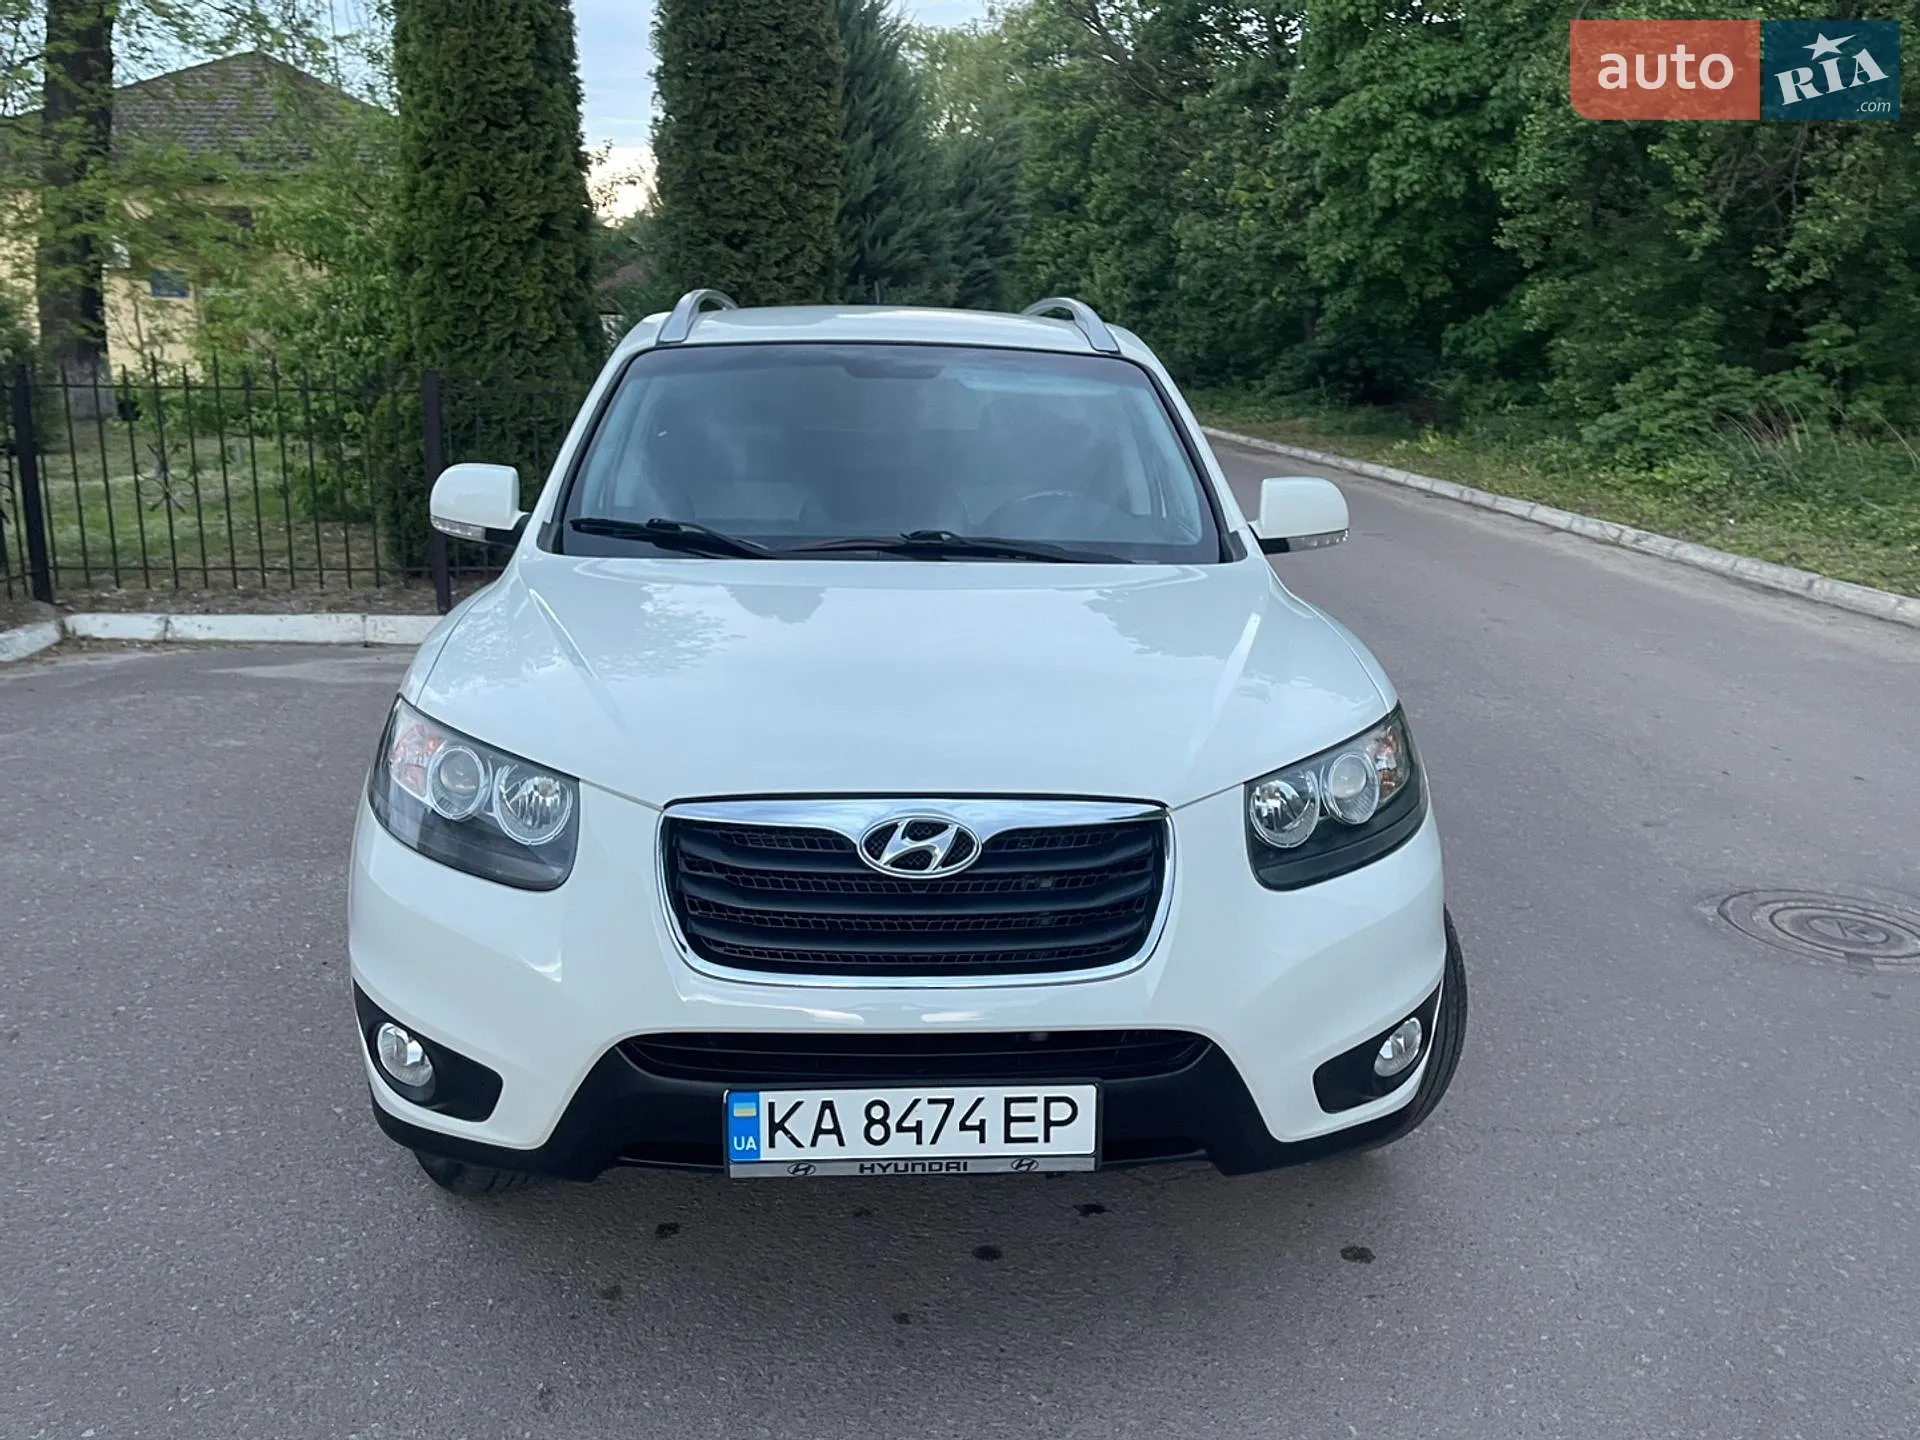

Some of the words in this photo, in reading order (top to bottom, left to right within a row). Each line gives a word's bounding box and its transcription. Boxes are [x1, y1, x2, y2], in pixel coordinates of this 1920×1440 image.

[767, 1099, 846, 1149] KA
[863, 1097, 987, 1146] 8474
[1003, 1095, 1079, 1145] EP
[734, 1136, 757, 1151] UA
[858, 1161, 968, 1174] HYUNDAI
